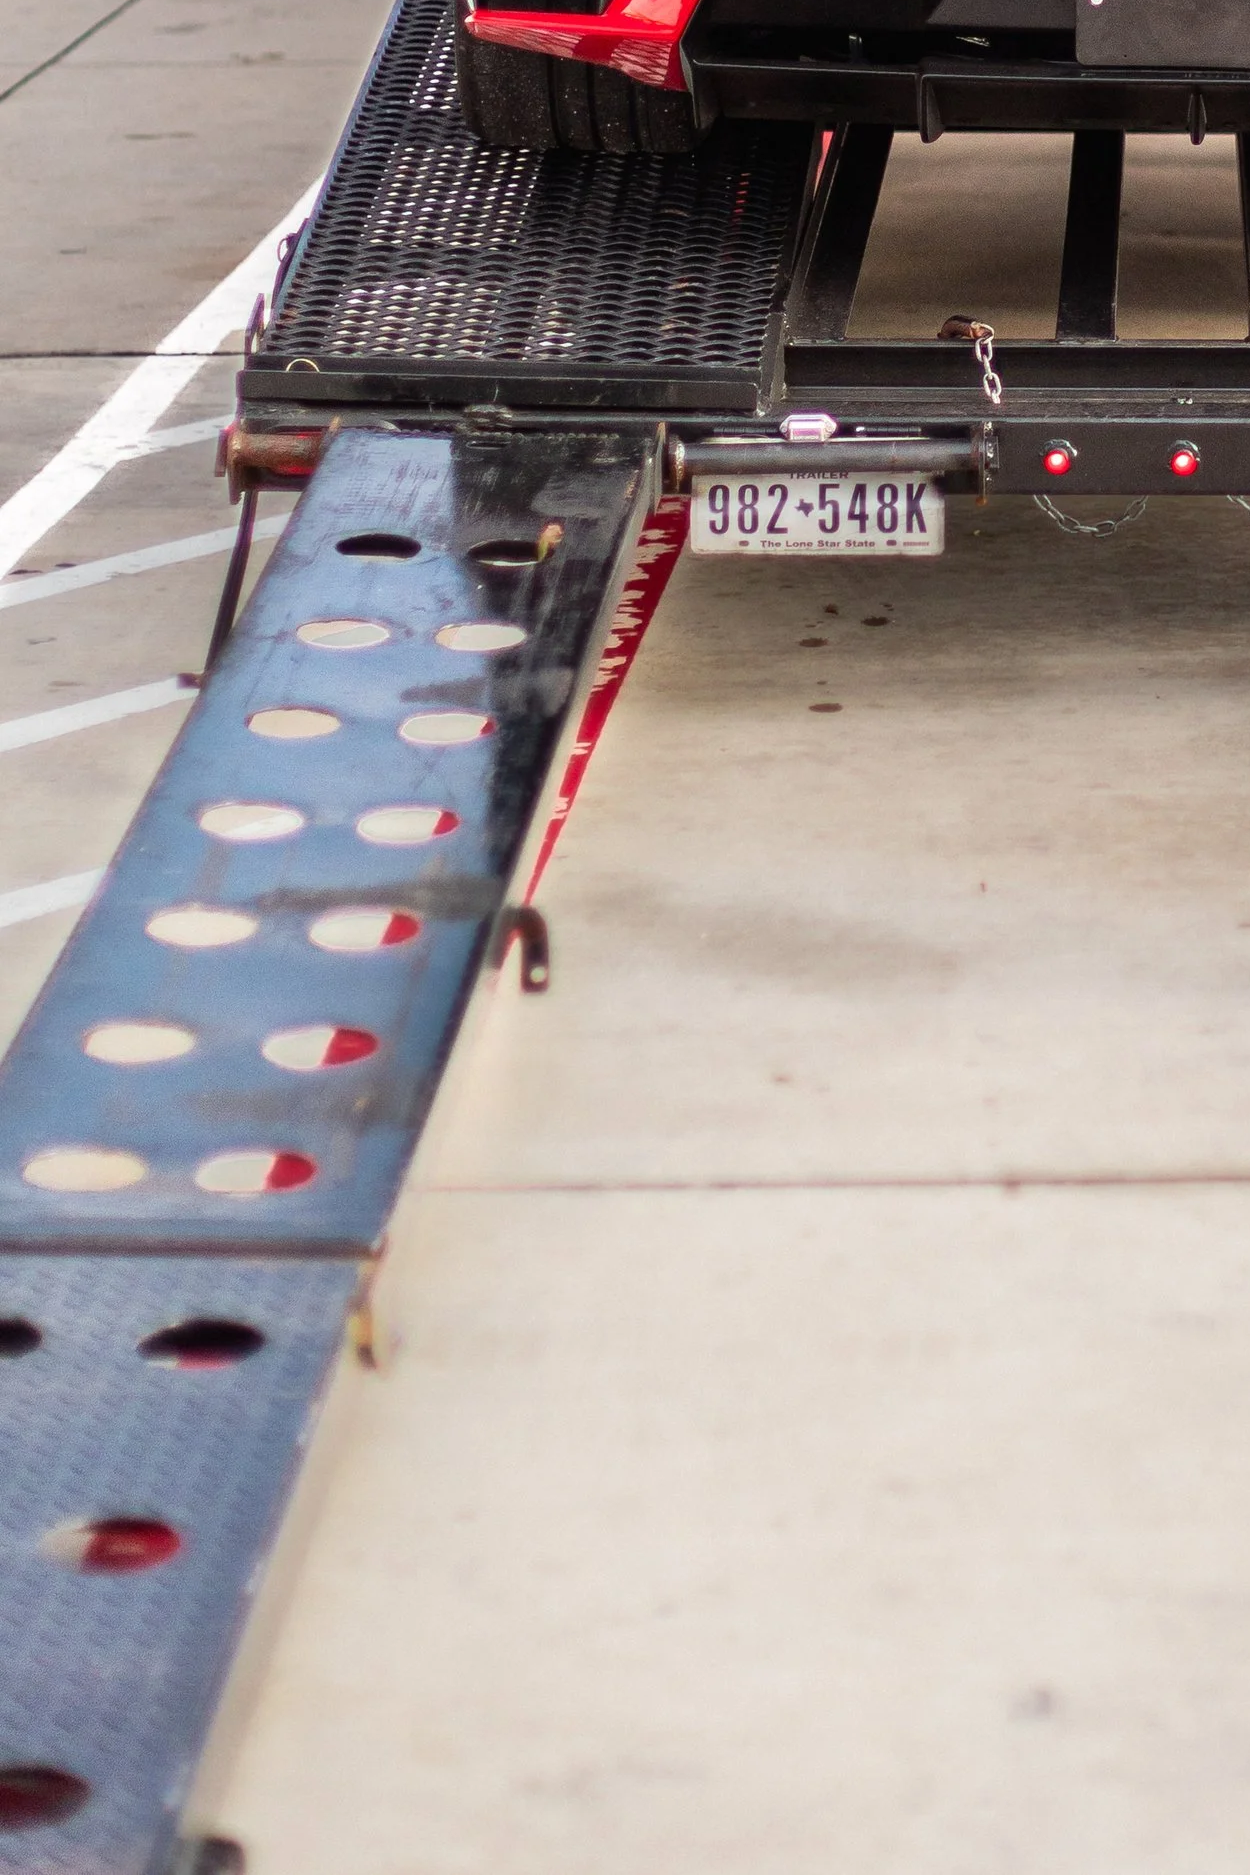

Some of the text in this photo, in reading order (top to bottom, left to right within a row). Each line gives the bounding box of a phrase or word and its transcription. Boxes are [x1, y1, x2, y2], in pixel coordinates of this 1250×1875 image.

[760, 539, 876, 548] The Lone Star State
